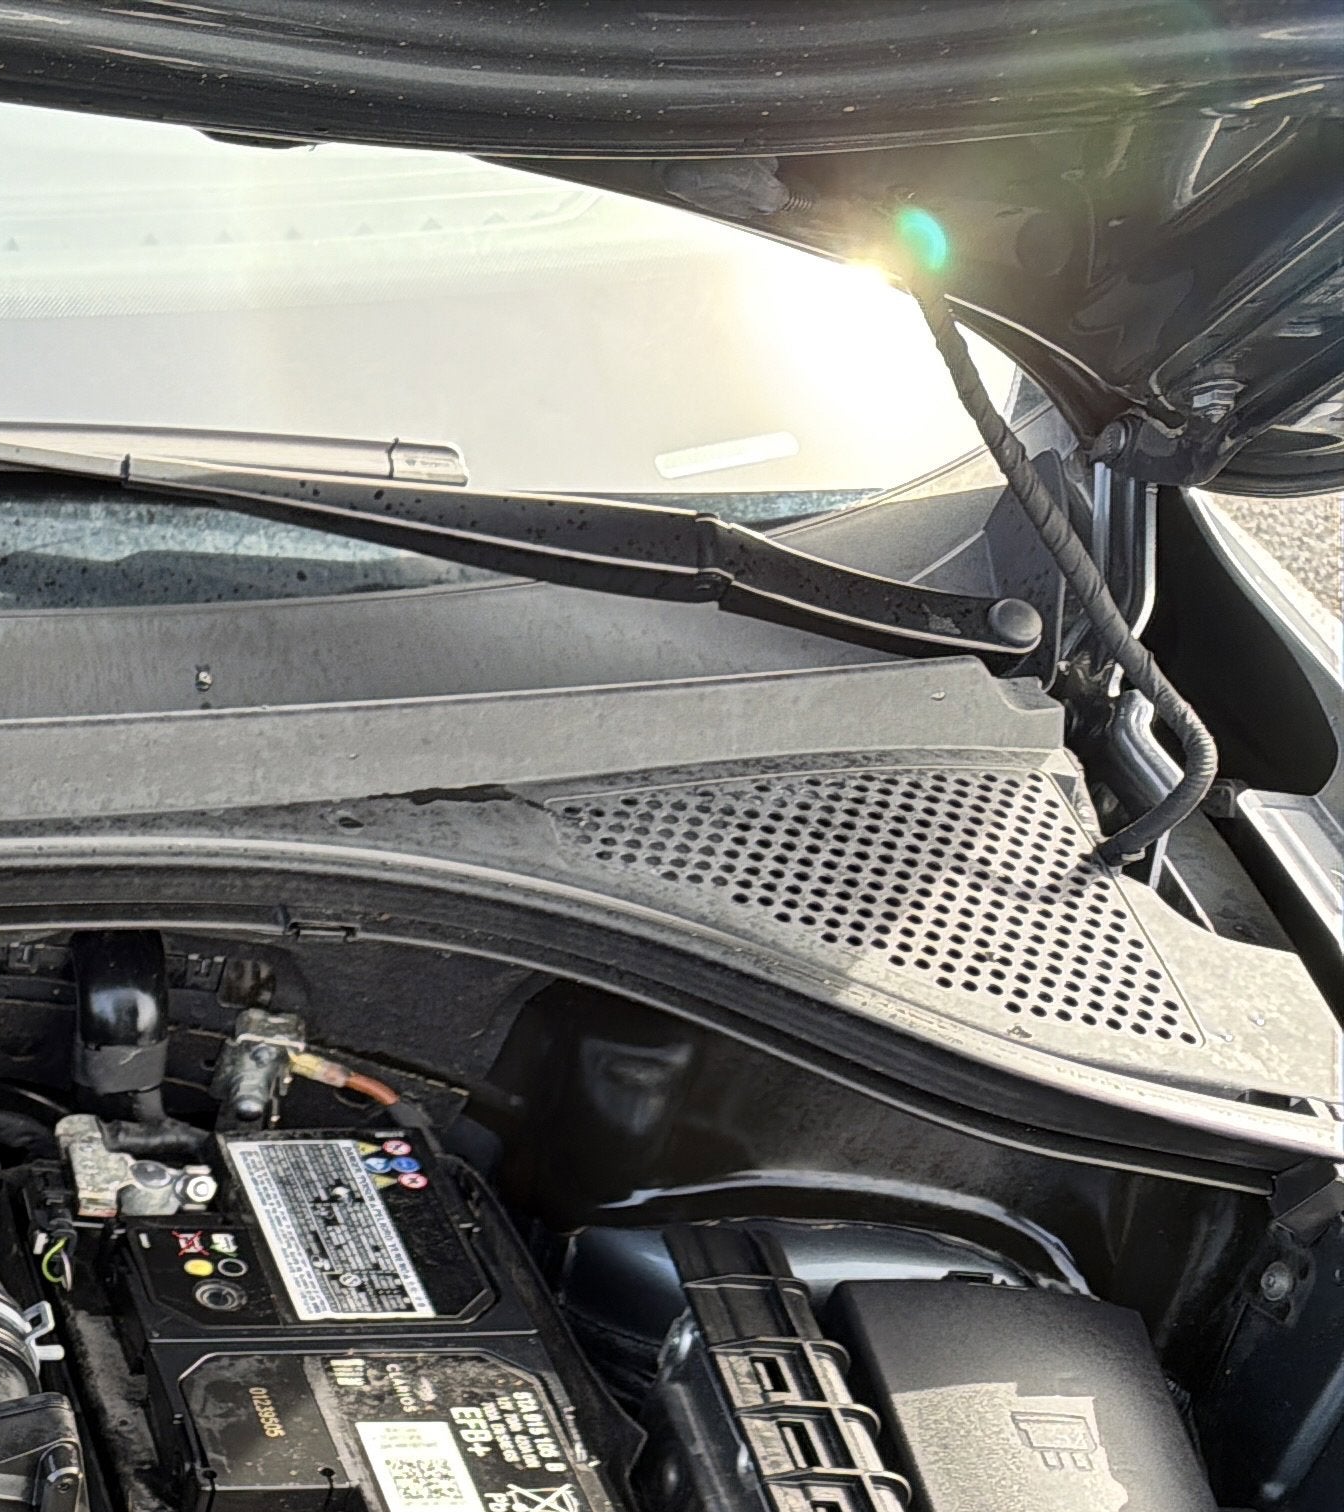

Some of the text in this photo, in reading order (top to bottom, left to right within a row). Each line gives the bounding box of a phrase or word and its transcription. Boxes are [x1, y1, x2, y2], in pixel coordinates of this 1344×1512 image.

[385, 1363, 419, 1413] CLARIOS
[450, 1407, 492, 1457] EFB+
[484, 1492, 511, 1512] Pb
